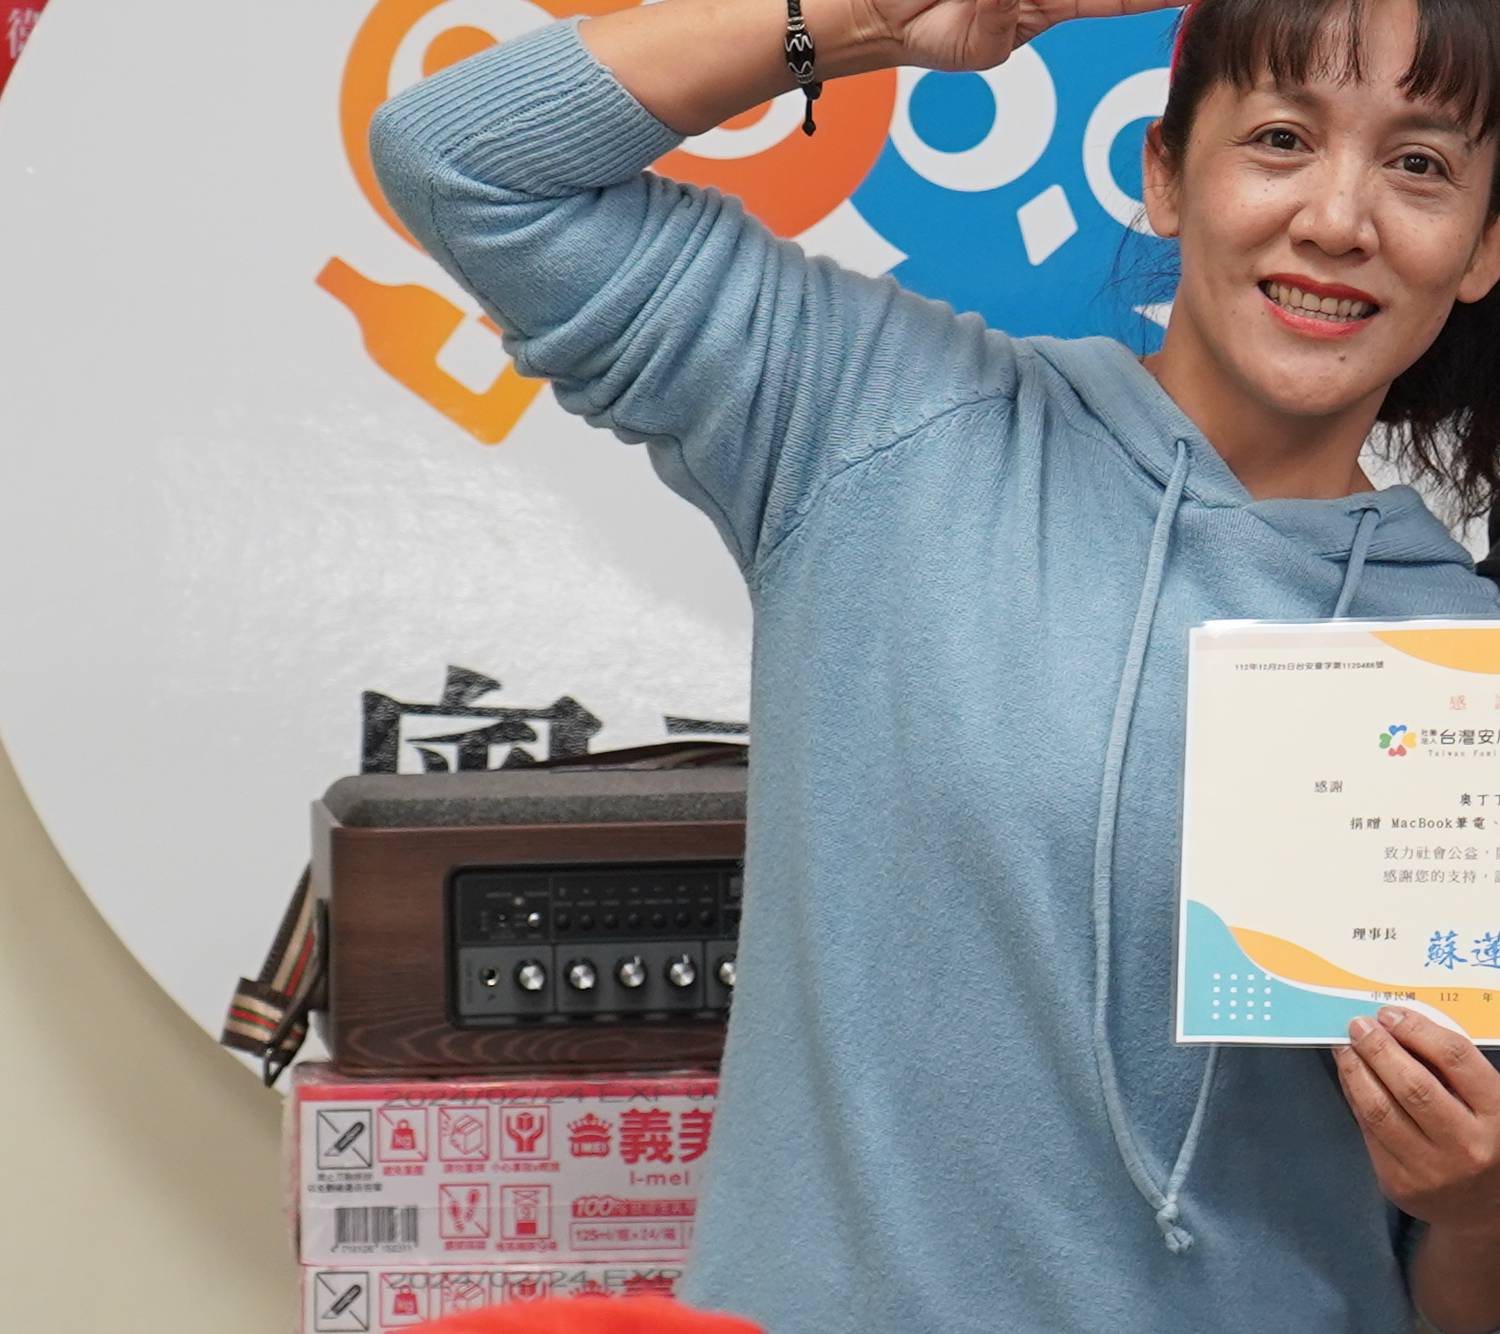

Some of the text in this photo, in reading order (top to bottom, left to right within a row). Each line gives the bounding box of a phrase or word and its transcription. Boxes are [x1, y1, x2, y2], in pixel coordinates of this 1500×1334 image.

[1313, 780, 1344, 794] 感謝
[1349, 816, 1382, 831] 捐贈
[1351, 927, 1398, 942] 理事長
[1438, 992, 1460, 1003] 112
[1481, 991, 1494, 1004] 年
